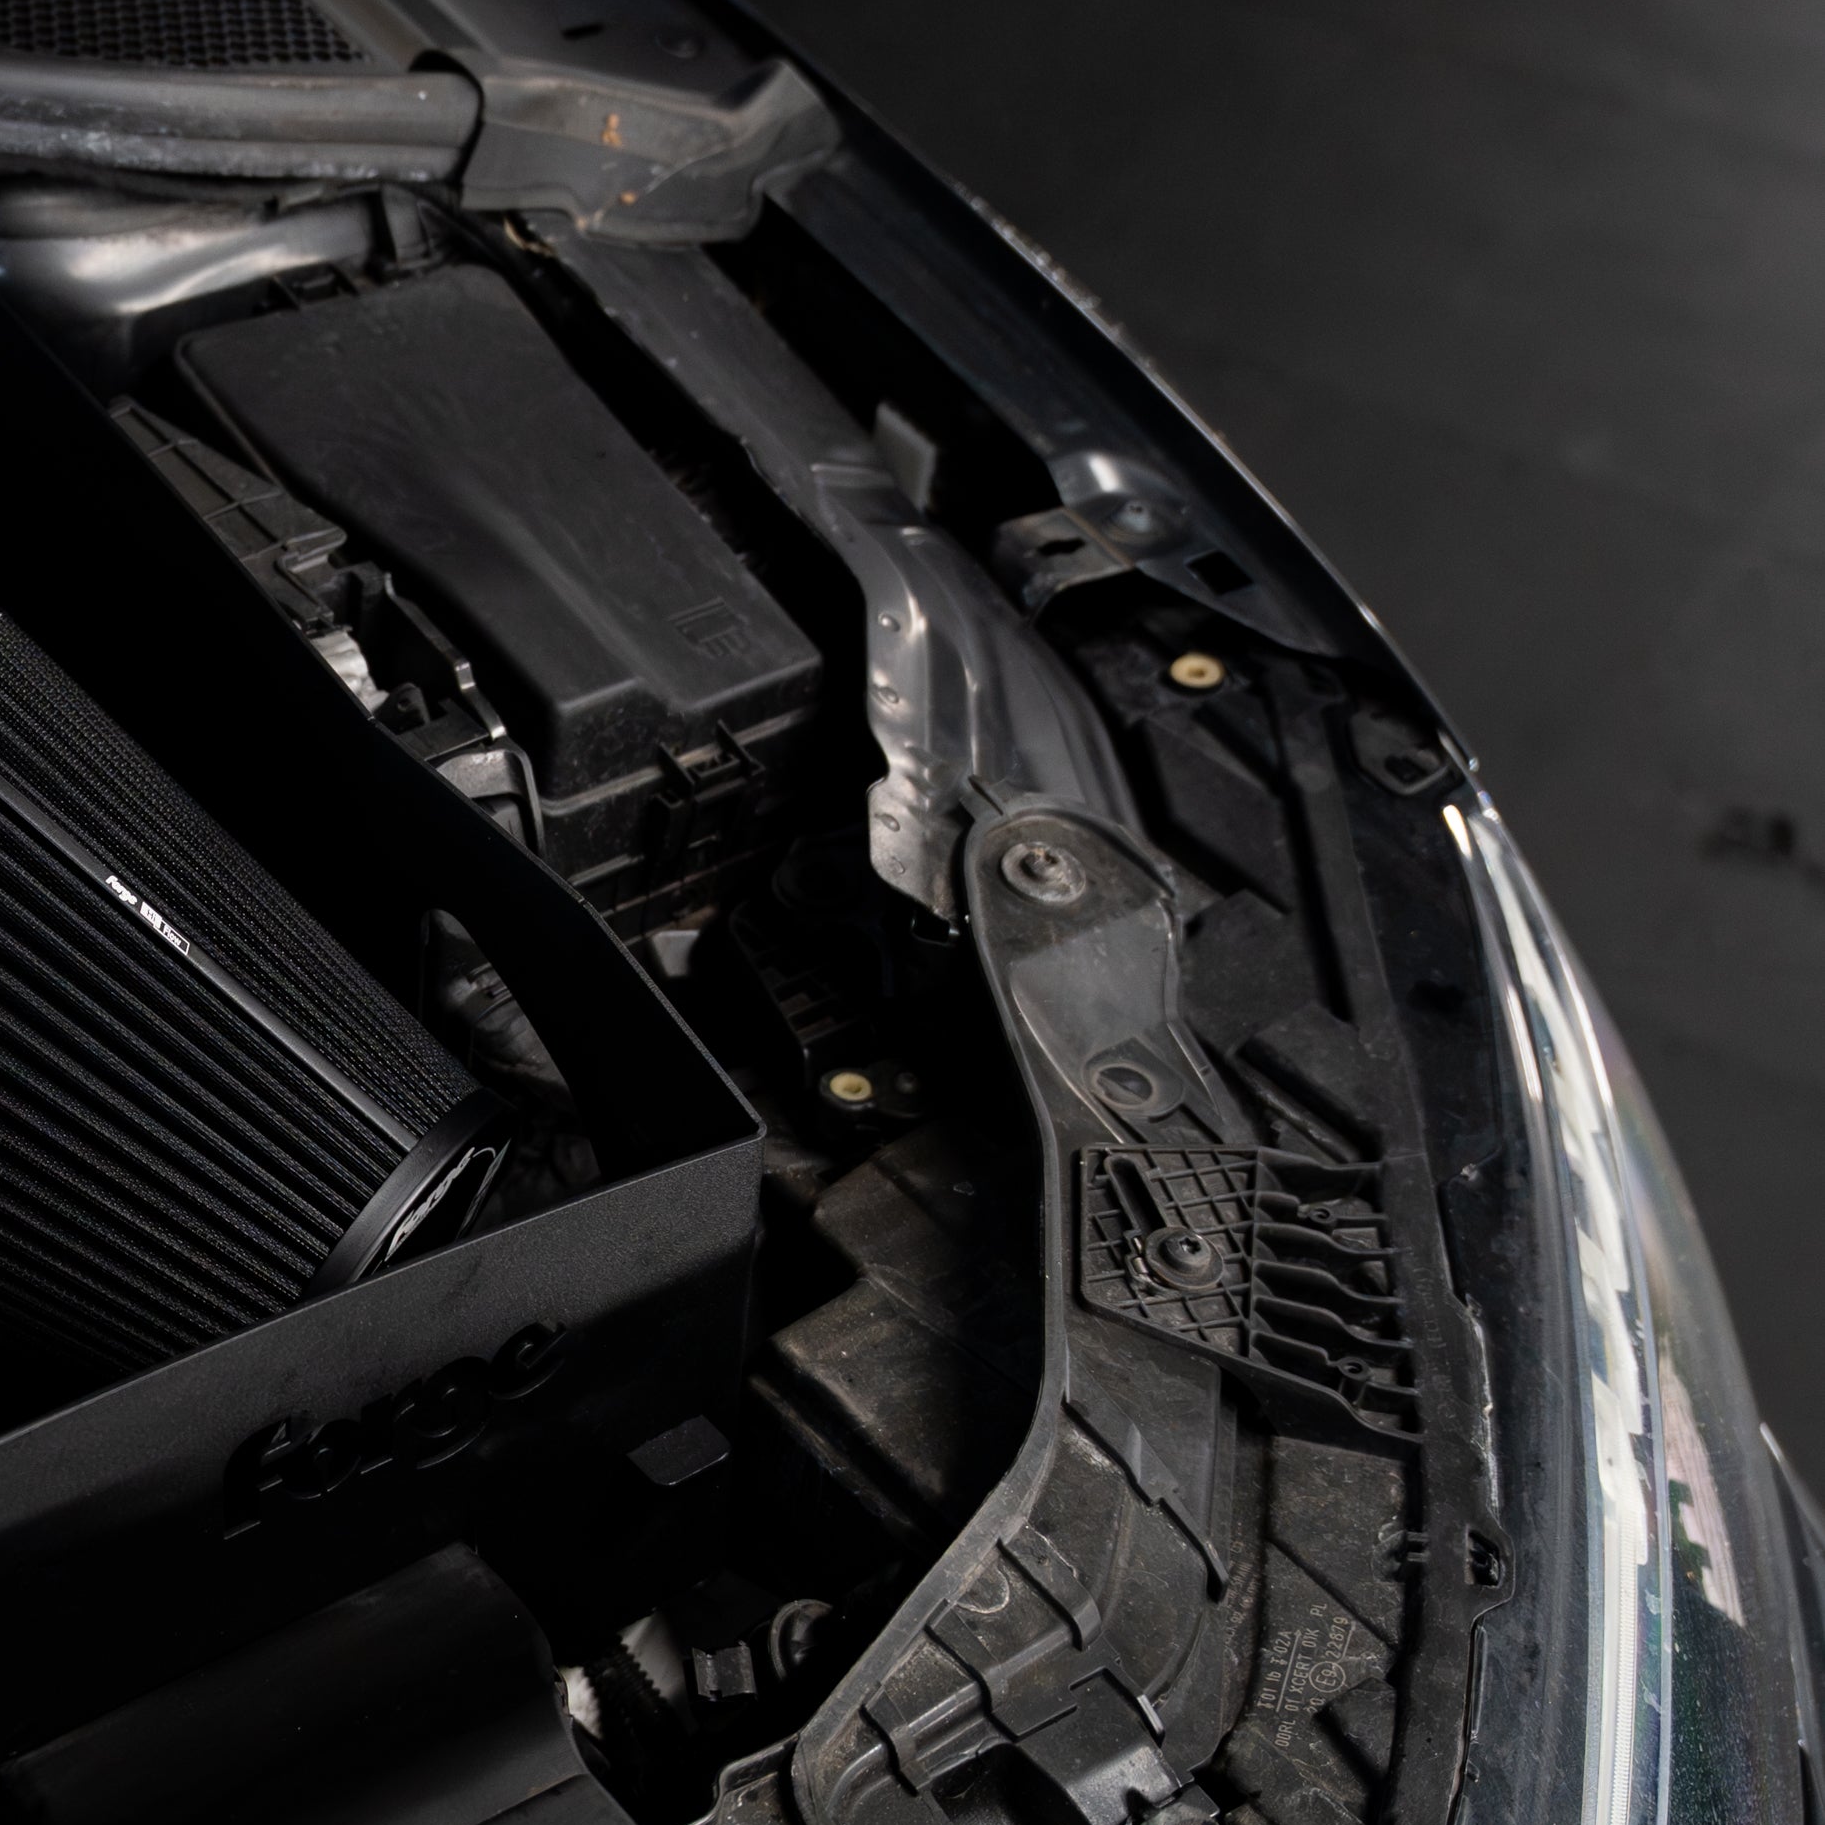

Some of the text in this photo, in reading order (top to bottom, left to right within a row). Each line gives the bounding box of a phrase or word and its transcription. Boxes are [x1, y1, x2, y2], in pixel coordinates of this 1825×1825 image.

[162, 923, 182, 946] Flow
[1310, 1603, 1327, 1617] PL
[1325, 1616, 1349, 1659] 22879
